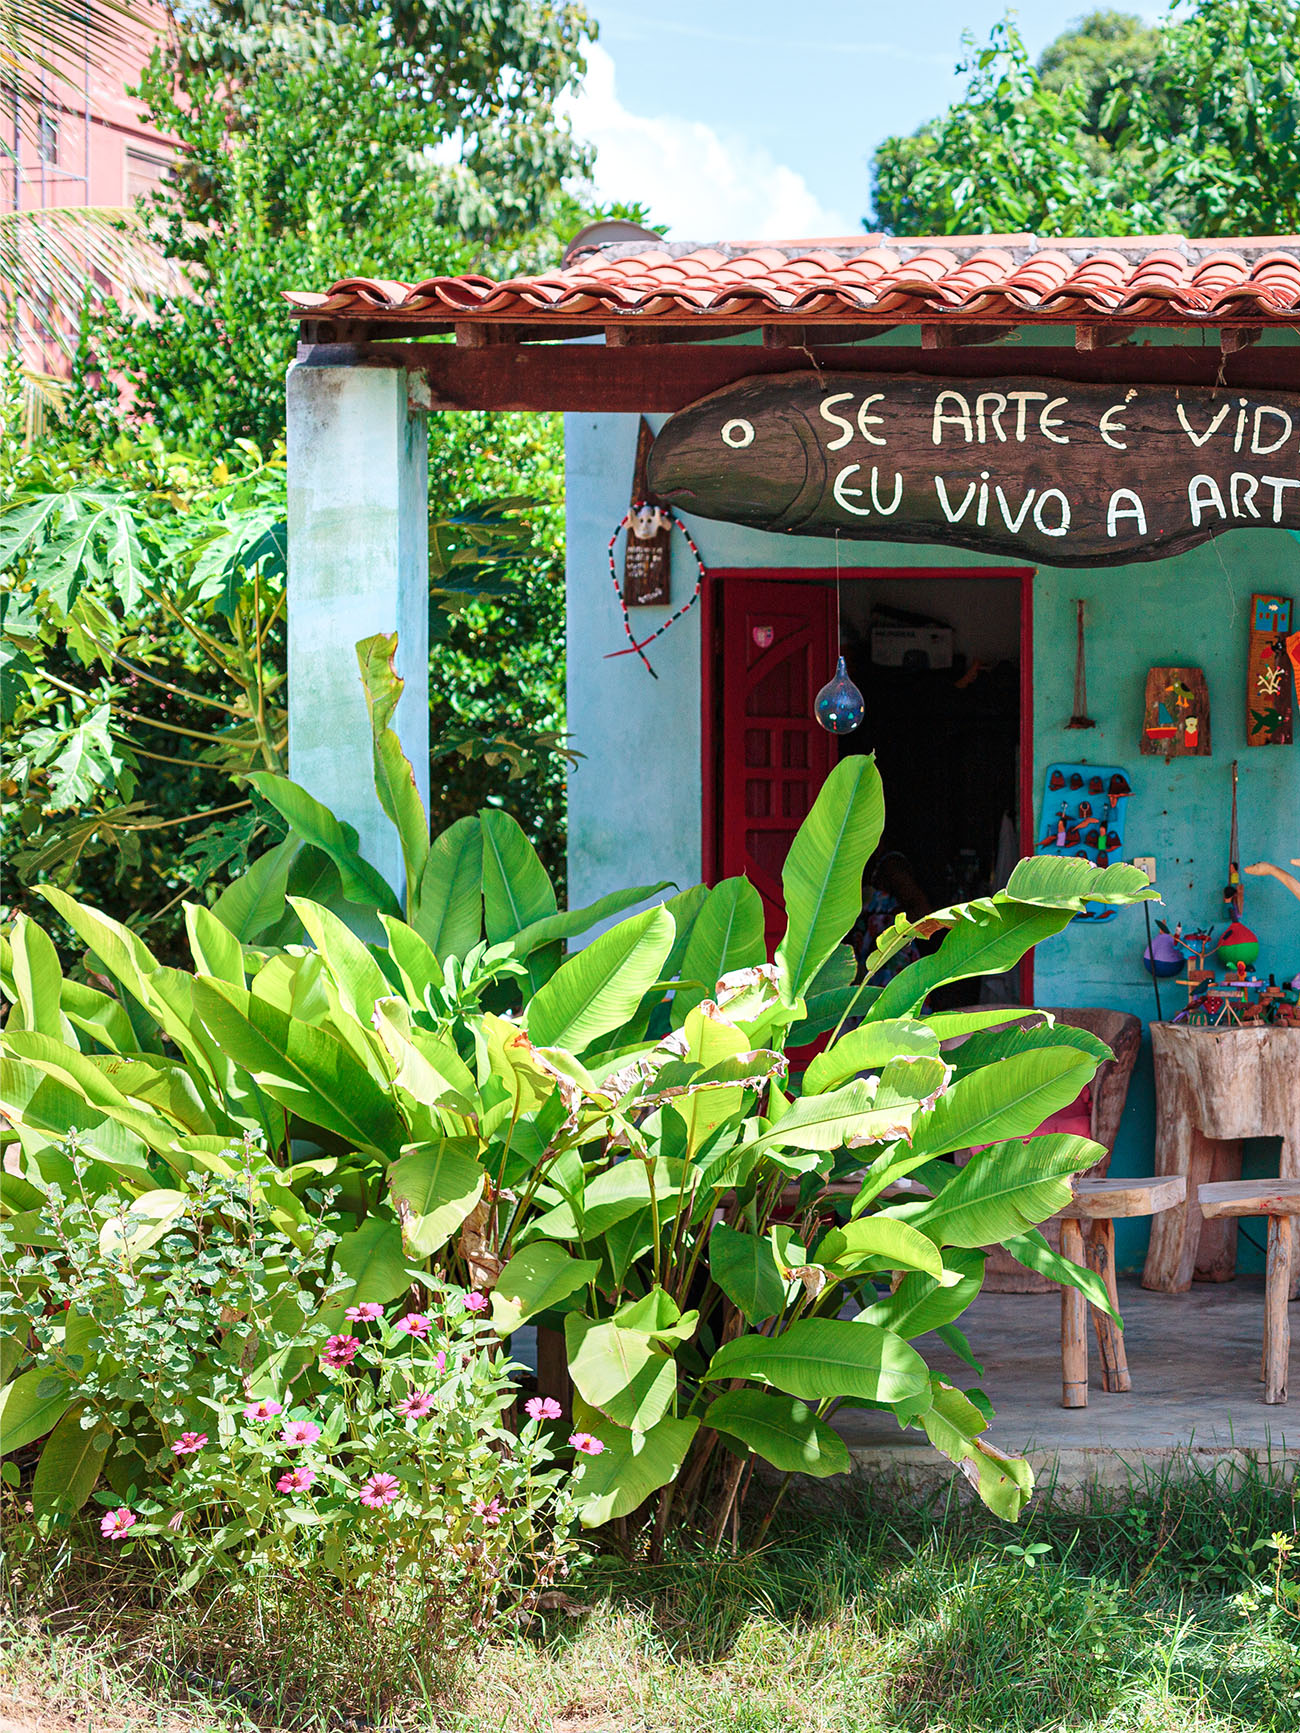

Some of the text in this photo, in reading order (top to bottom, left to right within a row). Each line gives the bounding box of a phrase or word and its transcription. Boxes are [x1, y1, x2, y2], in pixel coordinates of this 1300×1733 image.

[820, 392, 887, 452] SE
[932, 391, 1069, 445] ARTE
[1099, 388, 1138, 449] É
[833, 464, 903, 515] EU
[1107, 487, 1147, 538] A
